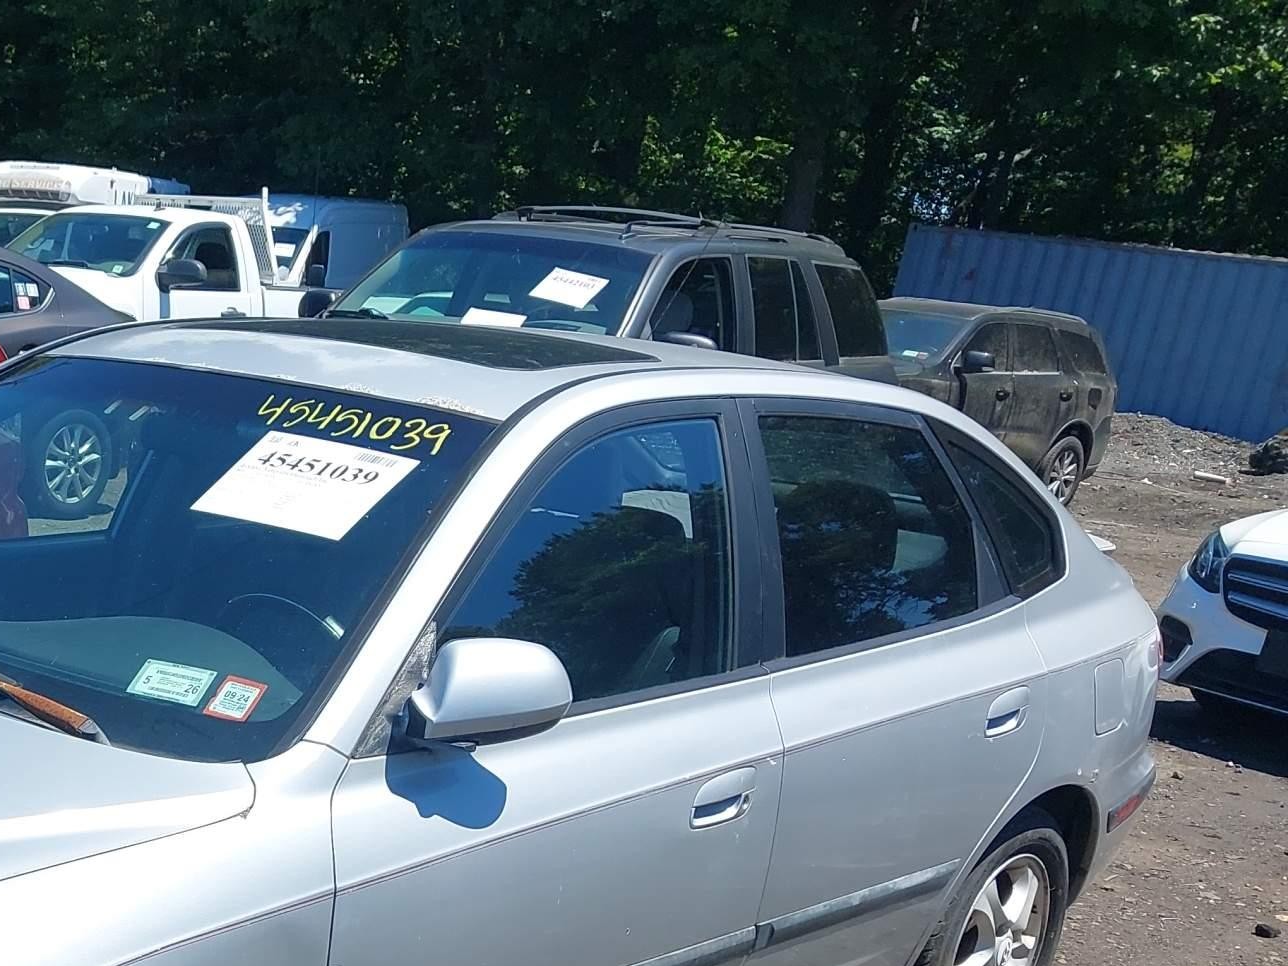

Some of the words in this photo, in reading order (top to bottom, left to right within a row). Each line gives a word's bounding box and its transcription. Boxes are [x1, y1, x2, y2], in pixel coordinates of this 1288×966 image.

[258, 395, 452, 455] 45451039
[258, 451, 380, 485] 45451039
[142, 675, 153, 685] 5
[184, 684, 200, 695] 26
